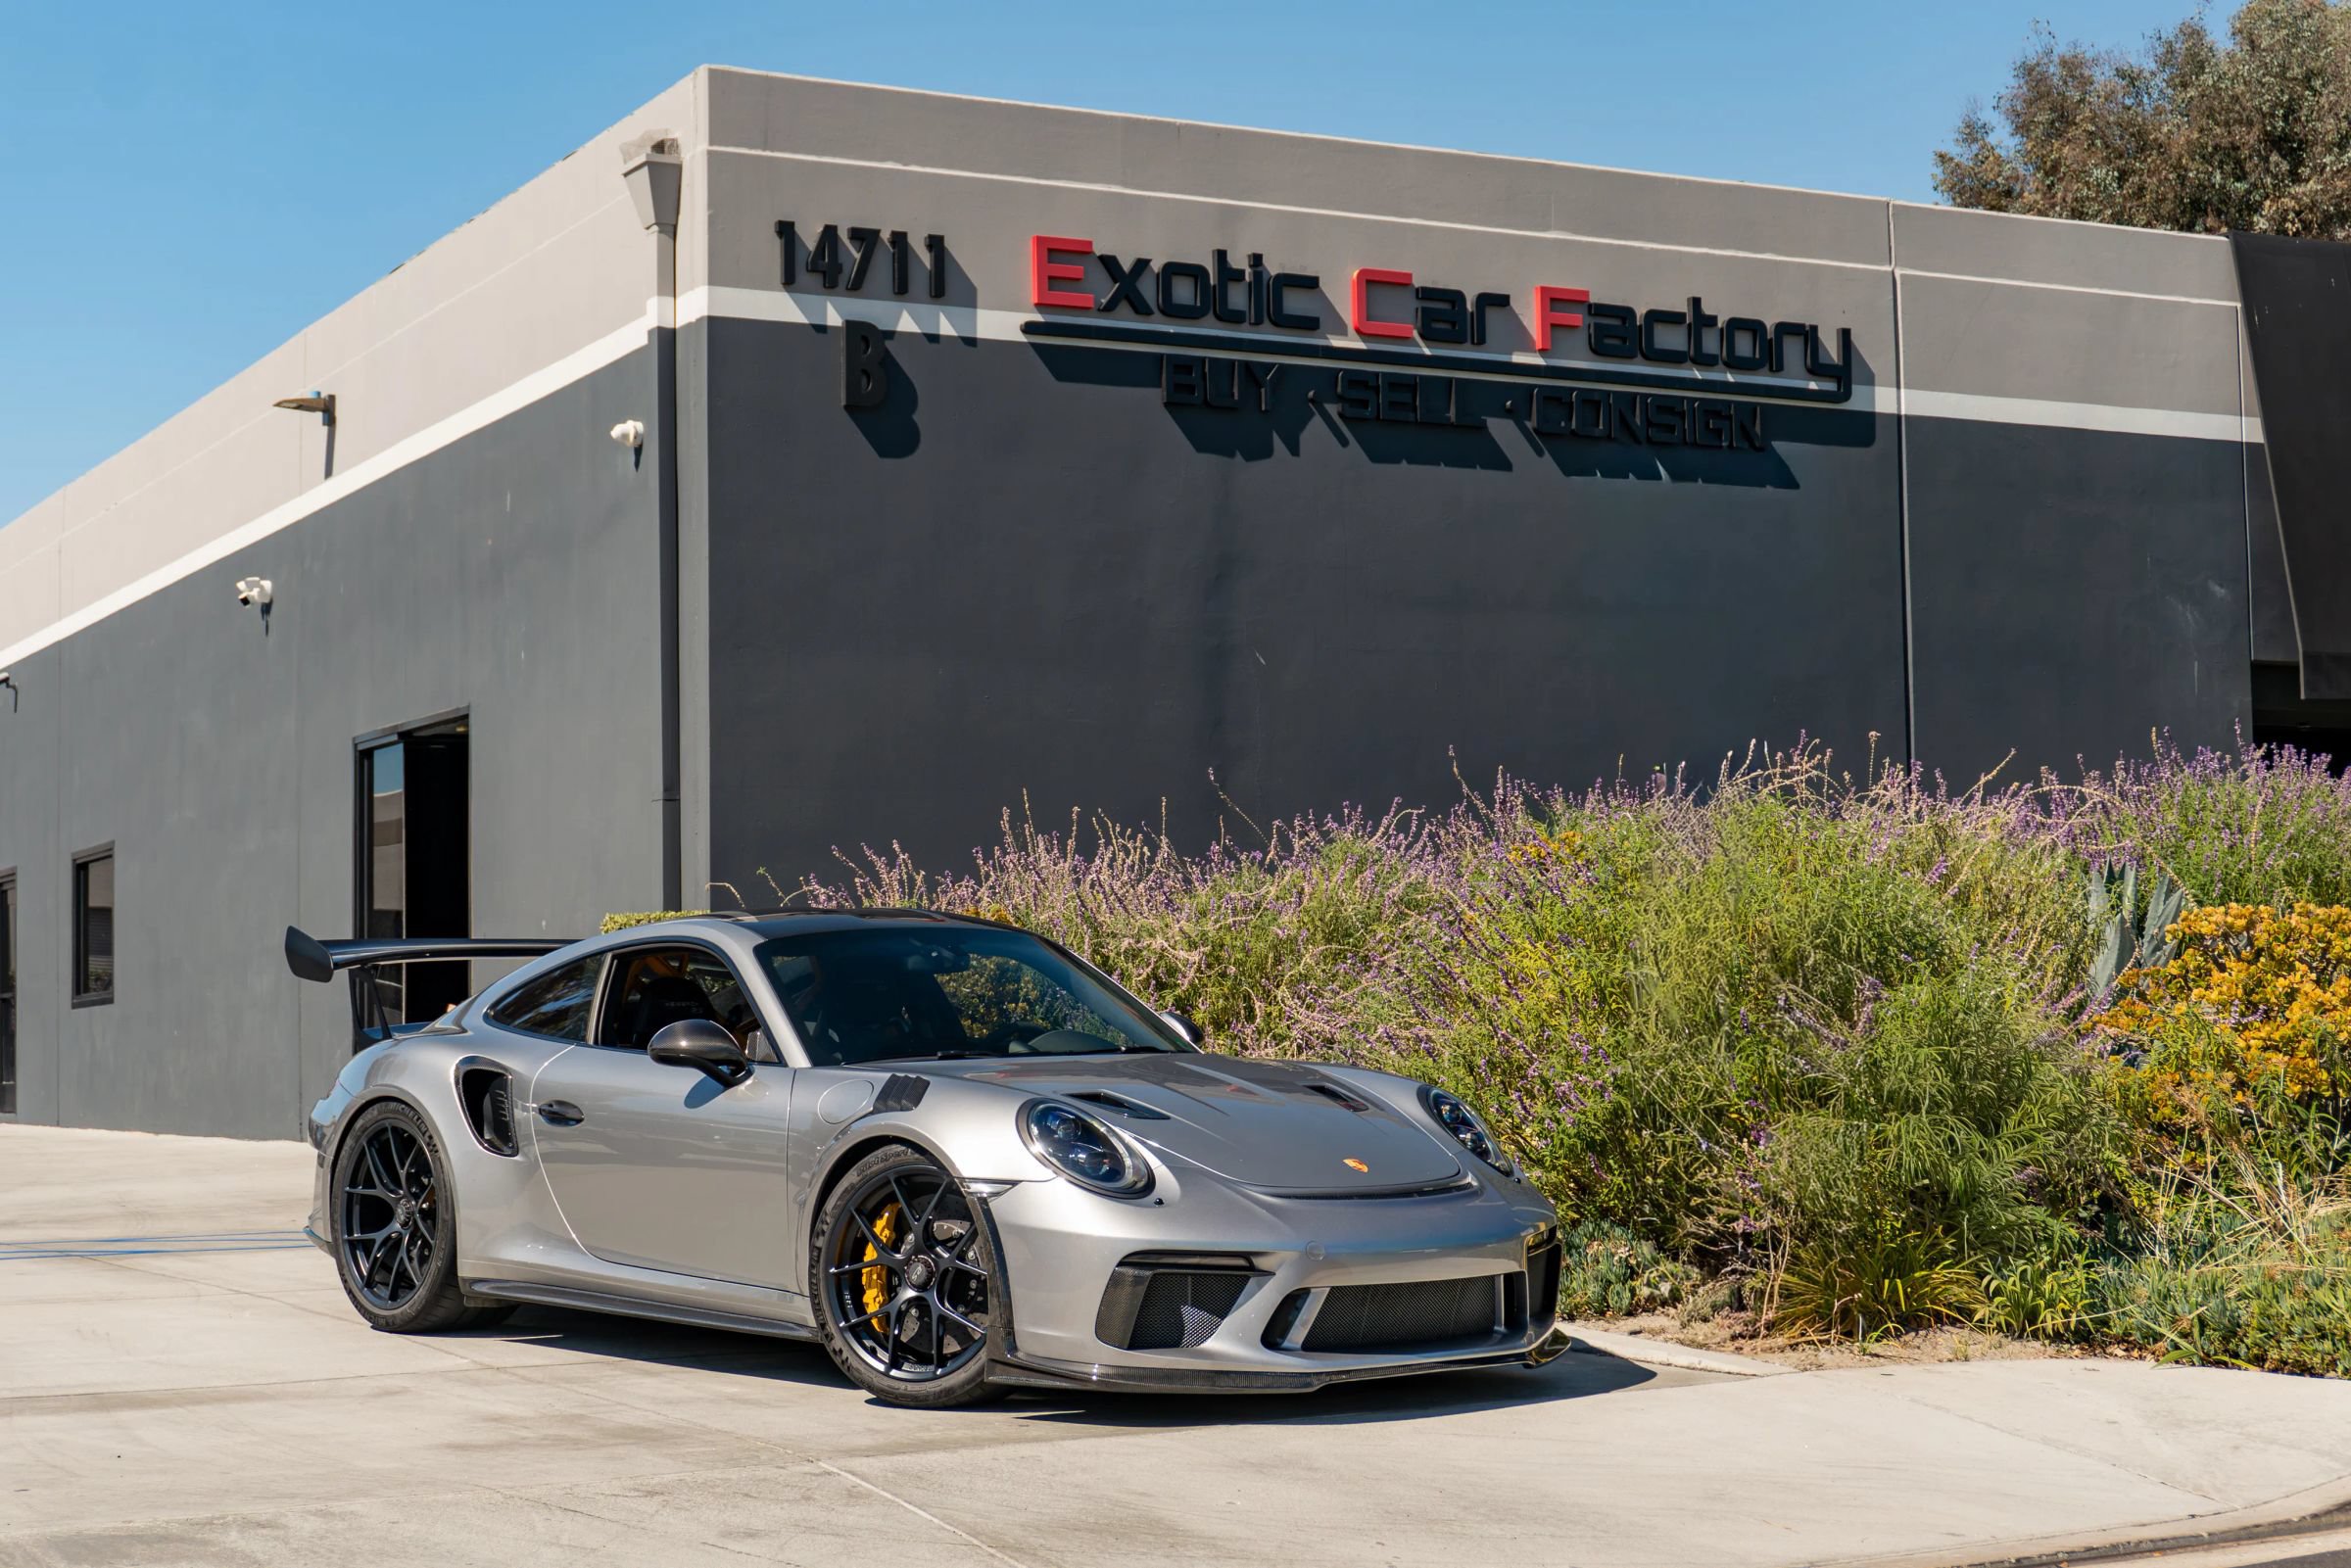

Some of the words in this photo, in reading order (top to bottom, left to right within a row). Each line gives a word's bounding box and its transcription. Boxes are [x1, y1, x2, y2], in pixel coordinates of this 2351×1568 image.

[775, 219, 945, 298] 14711
[840, 319, 884, 409] B
[1032, 234, 1320, 331] Exotic
[1352, 267, 1511, 345] Car
[1535, 285, 1852, 403] Factory
[1162, 354, 1279, 412] BUY
[1336, 369, 1487, 428] SELL
[1531, 387, 1765, 451] CONSIGN
